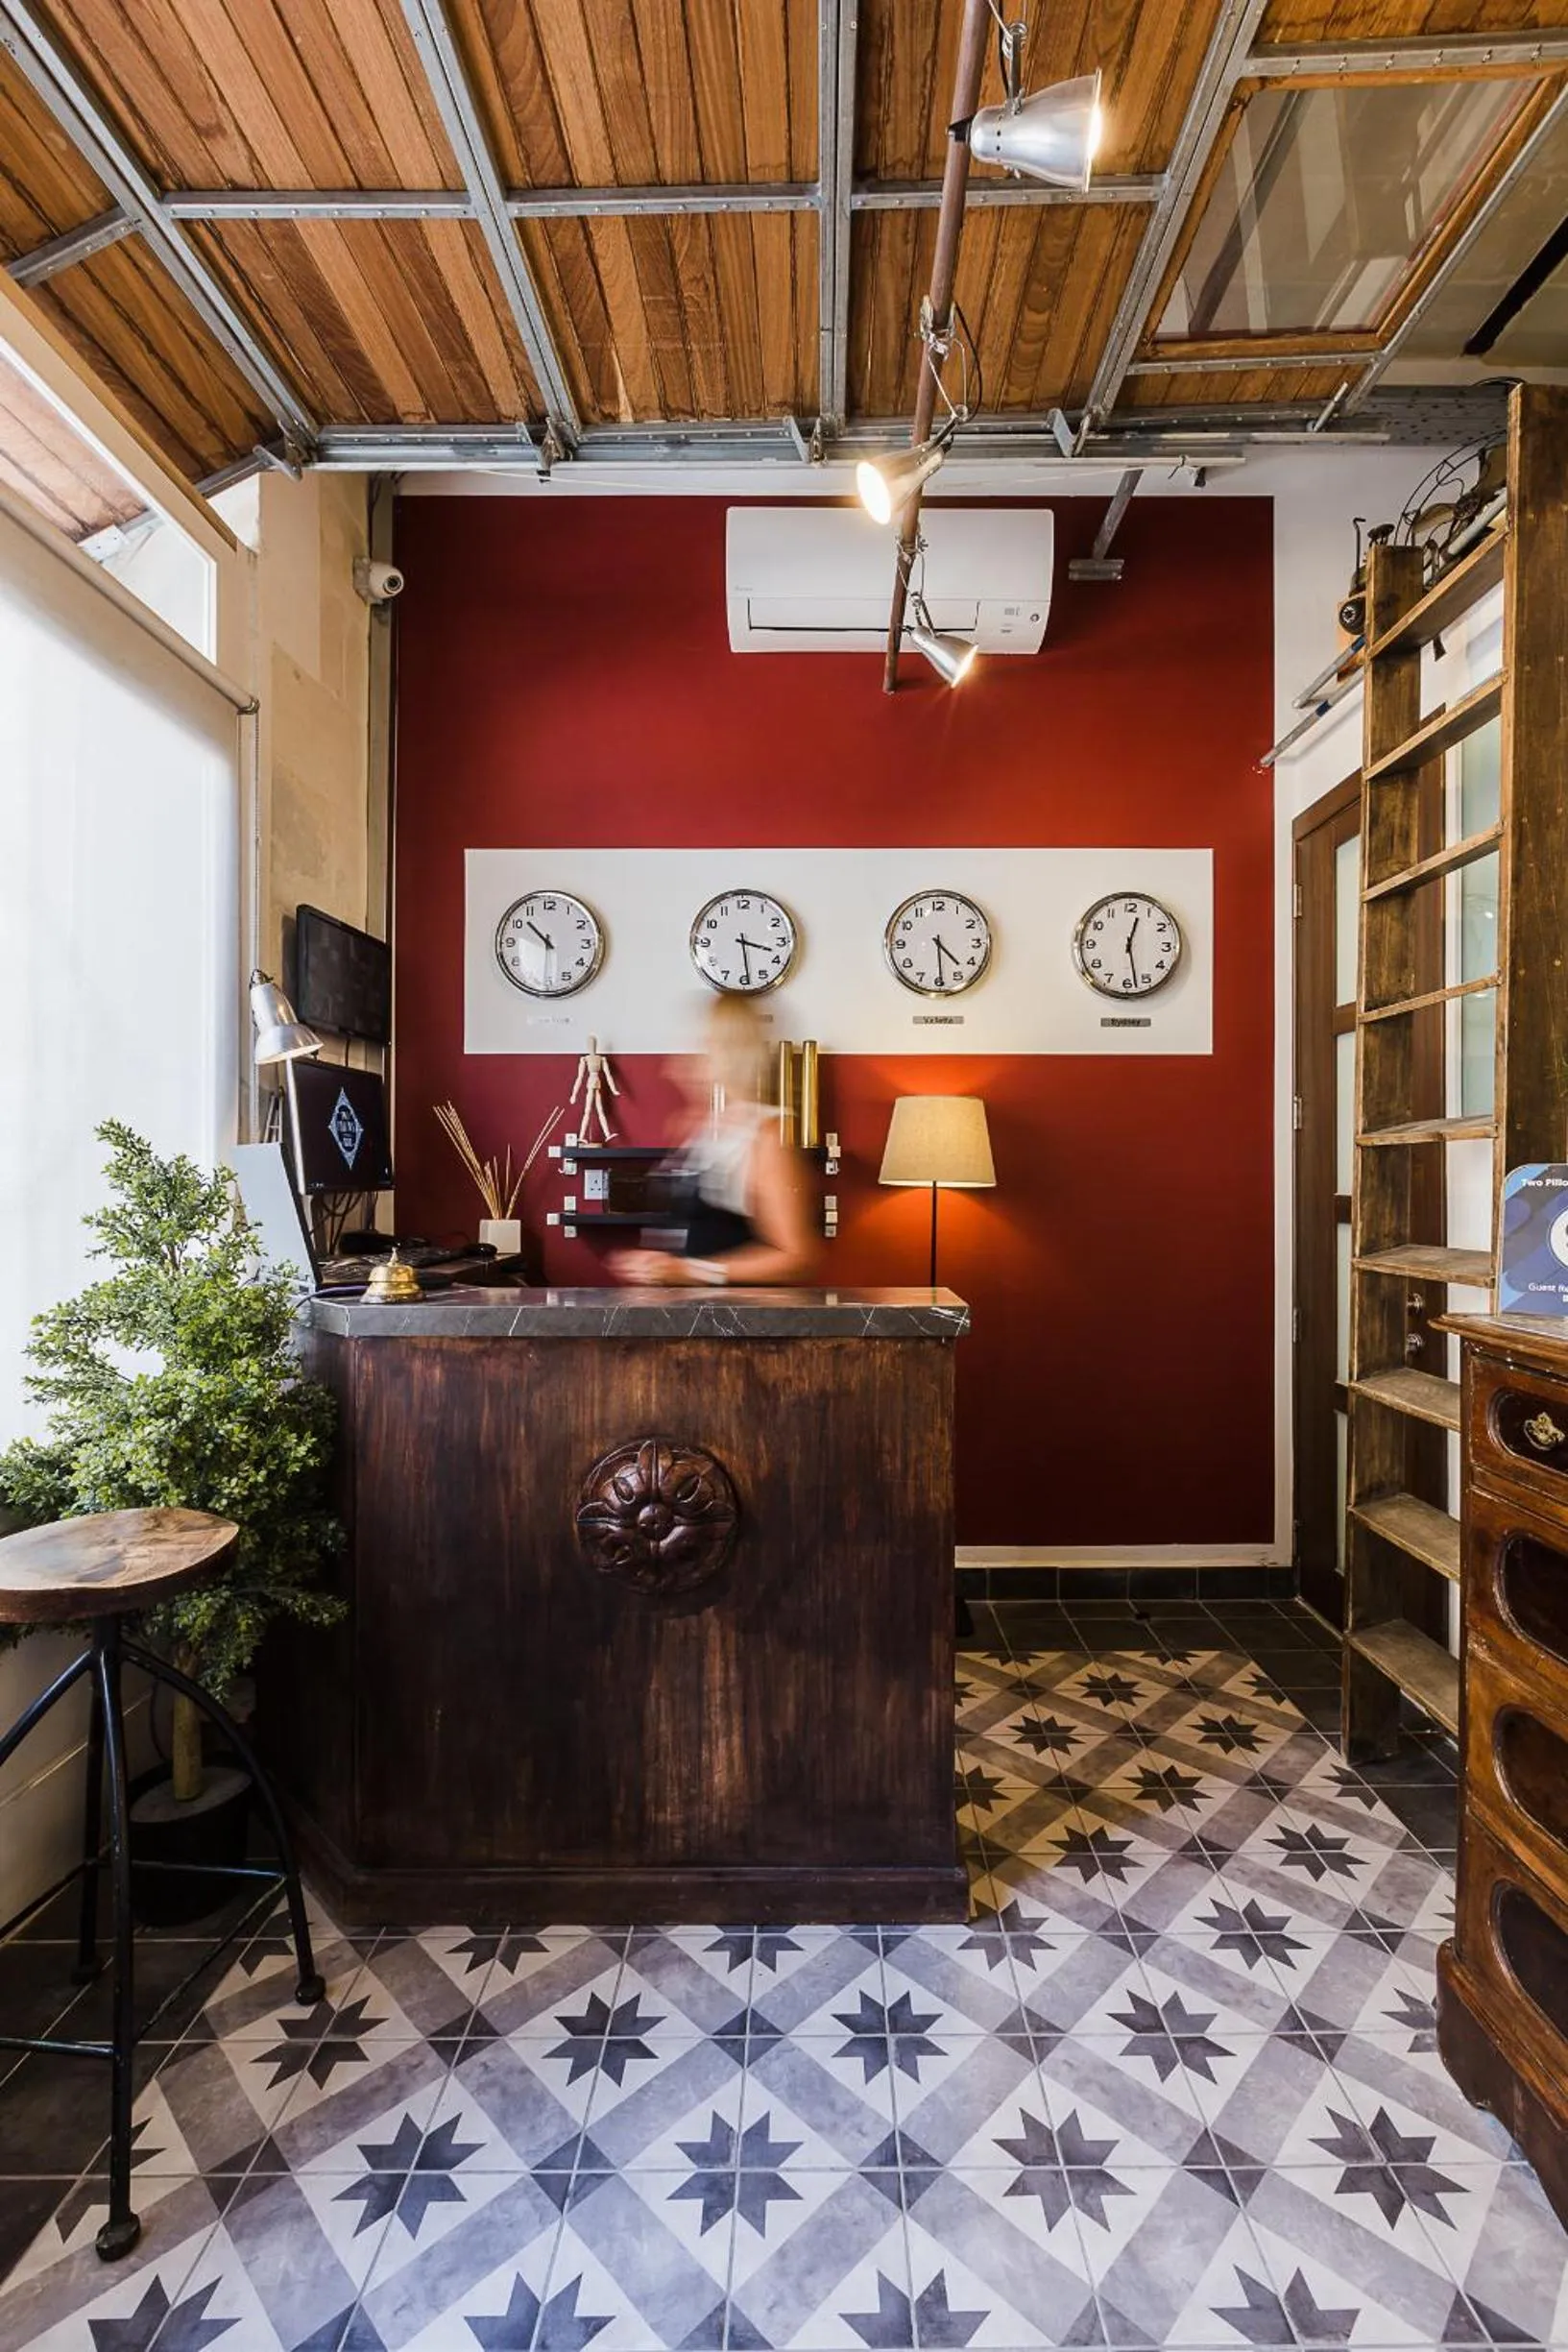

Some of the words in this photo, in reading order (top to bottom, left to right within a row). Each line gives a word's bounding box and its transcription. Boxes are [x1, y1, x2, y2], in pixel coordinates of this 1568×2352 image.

[543, 901, 557, 910] 12
[736, 900, 750, 909] 12
[932, 901, 945, 911] 12
[1124, 903, 1138, 913] 12
[526, 906, 534, 916] 11
[720, 906, 728, 916] 11
[915, 908, 923, 917] 11
[1107, 909, 1115, 918] 11
[512, 919, 522, 929] 10
[576, 919, 586, 930] 2
[707, 919, 717, 929] 10
[771, 918, 781, 927] 2
[903, 920, 913, 931] 10
[965, 919, 976, 929] 2
[1093, 921, 1104, 931] 10
[1156, 922, 1167, 933] 2
[505, 937, 516, 948] 9
[581, 938, 591, 949] 3
[700, 937, 711, 948] 9
[776, 937, 786, 947] 3
[895, 939, 905, 949] 9
[972, 938, 982, 949] 3
[1086, 939, 1097, 950] 9
[1161, 942, 1171, 952] 3
[575, 958, 585, 966] 4
[771, 956, 781, 965] 4
[903, 958, 913, 968] 8
[967, 957, 976, 966] 4
[1091, 958, 1101, 968] 8
[1155, 960, 1165, 970] 4
[561, 972, 572, 981] 5
[721, 970, 730, 981] 7
[739, 975, 750, 985] 6
[759, 970, 768, 980] 5
[916, 972, 926, 982] 7
[953, 972, 964, 981] 5
[1103, 973, 1114, 983] 7
[1141, 974, 1152, 983] 5
[934, 976, 945, 986] 6
[1122, 979, 1133, 988] 6
[1521, 1178, 1543, 1187] Two
[1529, 1282, 1556, 1293] Guest
